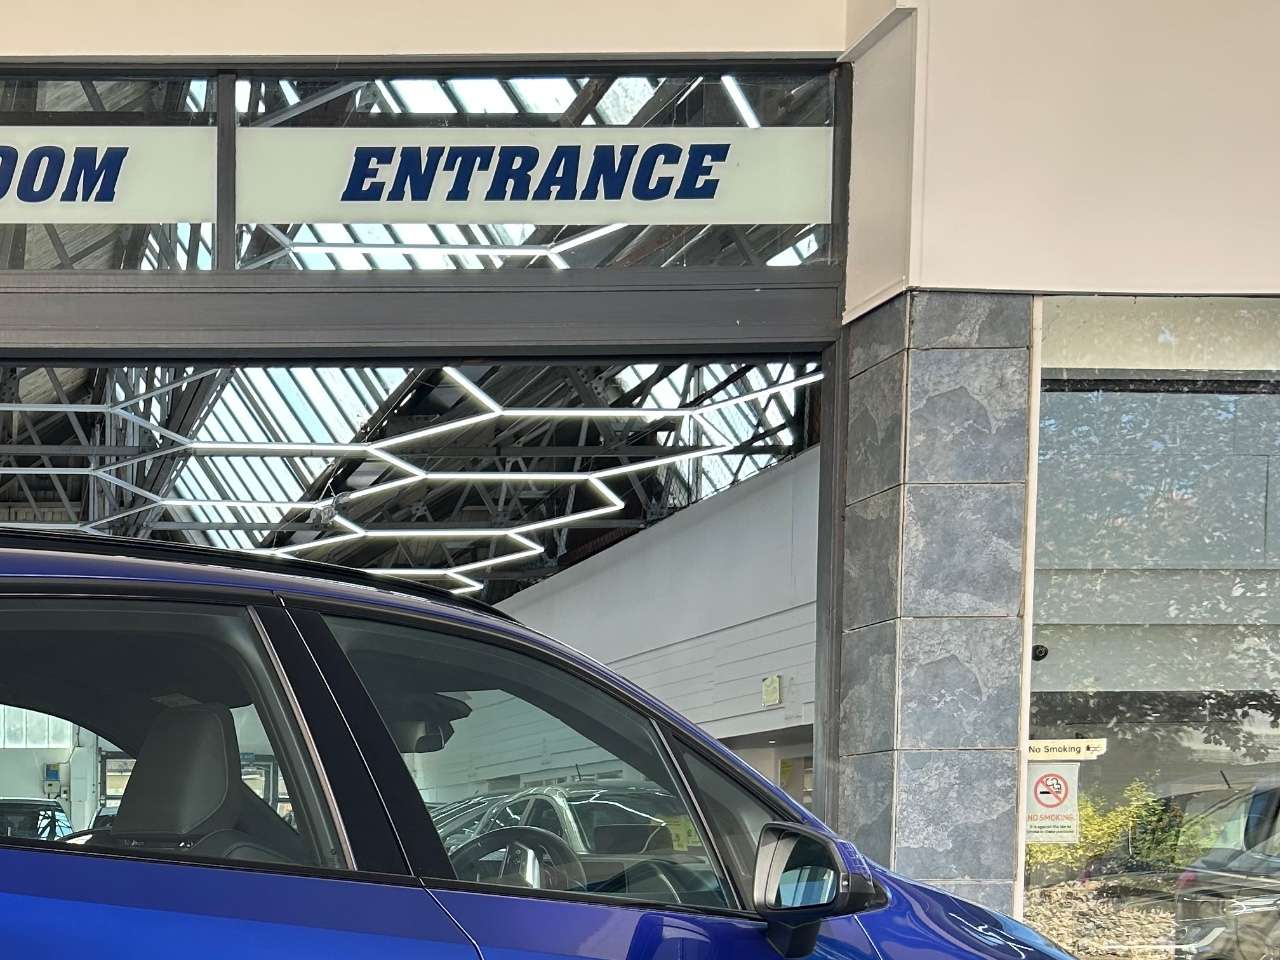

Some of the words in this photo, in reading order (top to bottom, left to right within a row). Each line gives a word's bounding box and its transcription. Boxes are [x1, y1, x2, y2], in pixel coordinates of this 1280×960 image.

[340, 143, 731, 202] ENTRANCE
[1028, 745, 1041, 753] No
[1043, 745, 1081, 754] Smoking
